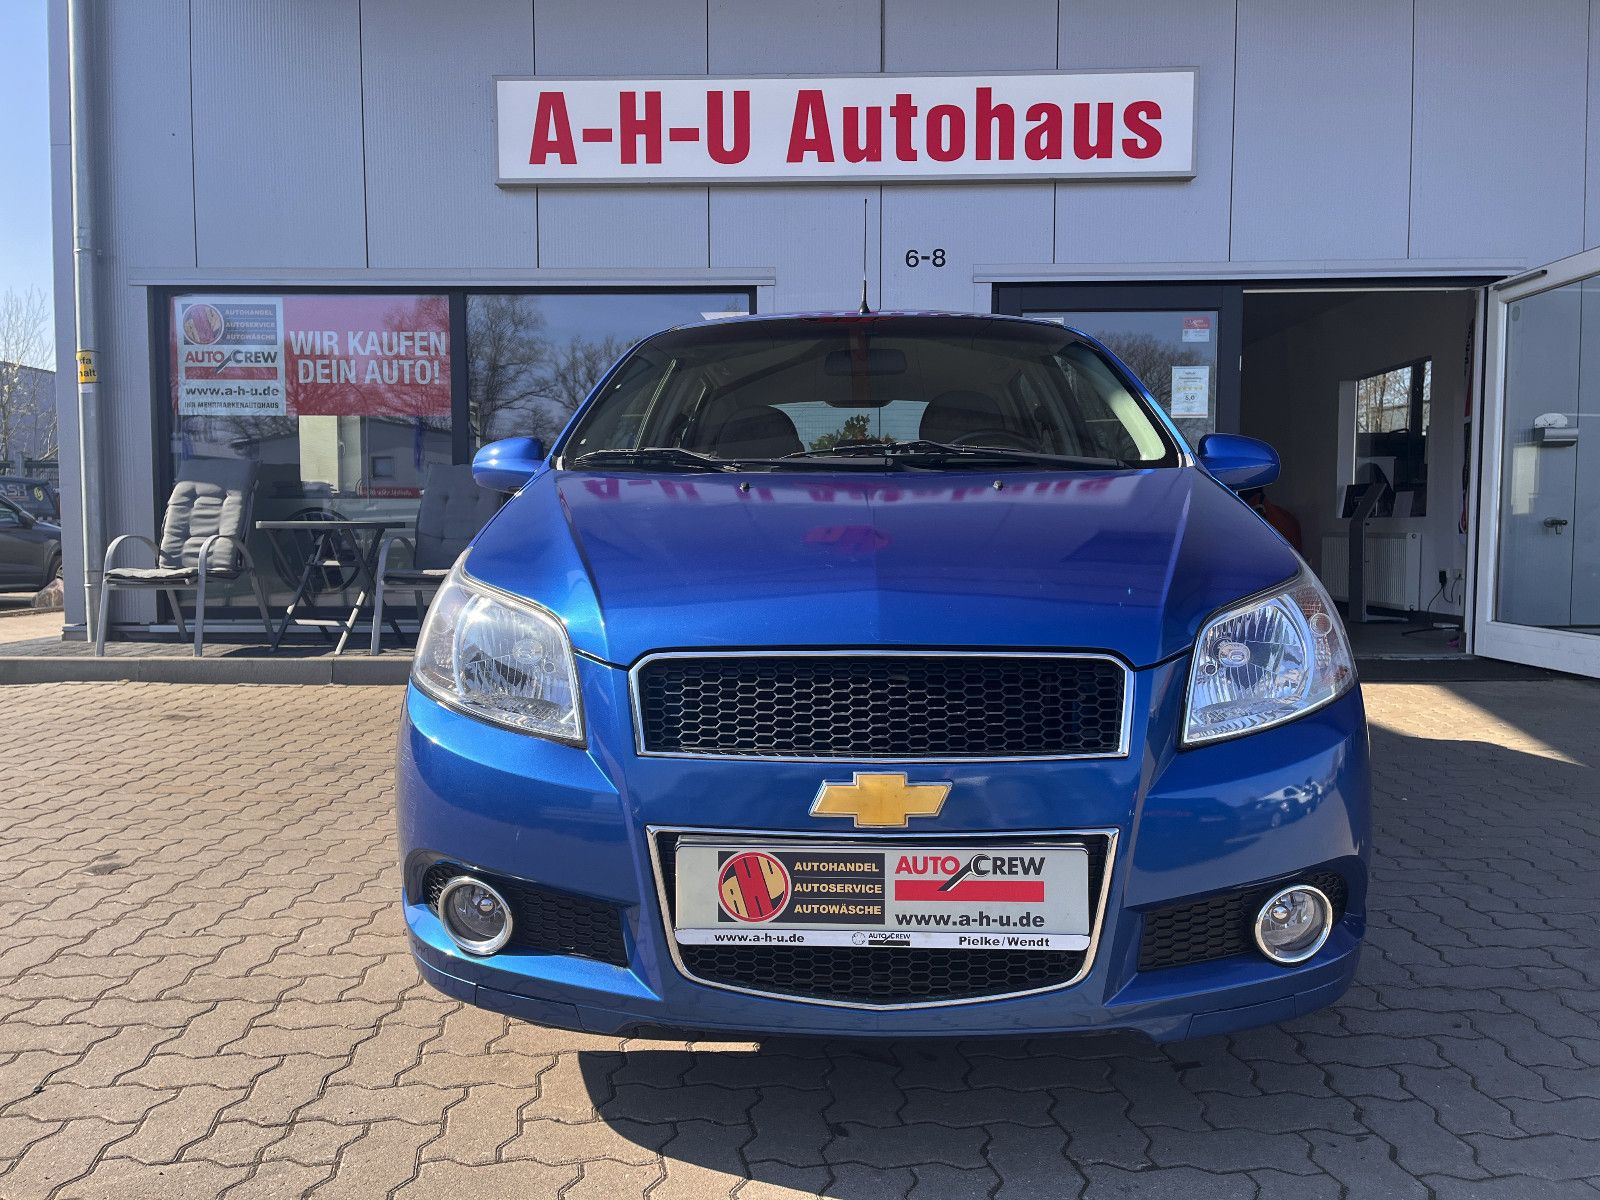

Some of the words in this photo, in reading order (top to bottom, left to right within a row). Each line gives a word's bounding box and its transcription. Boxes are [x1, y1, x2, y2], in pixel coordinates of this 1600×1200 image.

[528, 90, 751, 165] A-H-U
[785, 86, 1163, 164] Autohaus
[905, 248, 946, 268] 6-8
[289, 330, 339, 355] WIR
[347, 330, 447, 356] KAUFEN
[184, 350, 225, 364] AUTO
[231, 349, 277, 364] CREW
[298, 359, 357, 384] DEIN
[364, 359, 440, 385] AUTO!
[185, 386, 279, 396] www.a-h-u.de
[793, 862, 879, 872] AUTOHANDEL
[894, 855, 961, 875] AUTO
[971, 854, 1046, 877] CREW
[793, 883, 883, 894] AUTOSERVICE
[793, 904, 882, 915] AUTOWÄSCHE
[894, 911, 1046, 928] www.a-h-u.de
[714, 933, 805, 943] www.a-h-u.de
[890, 932, 911, 940] CREW
